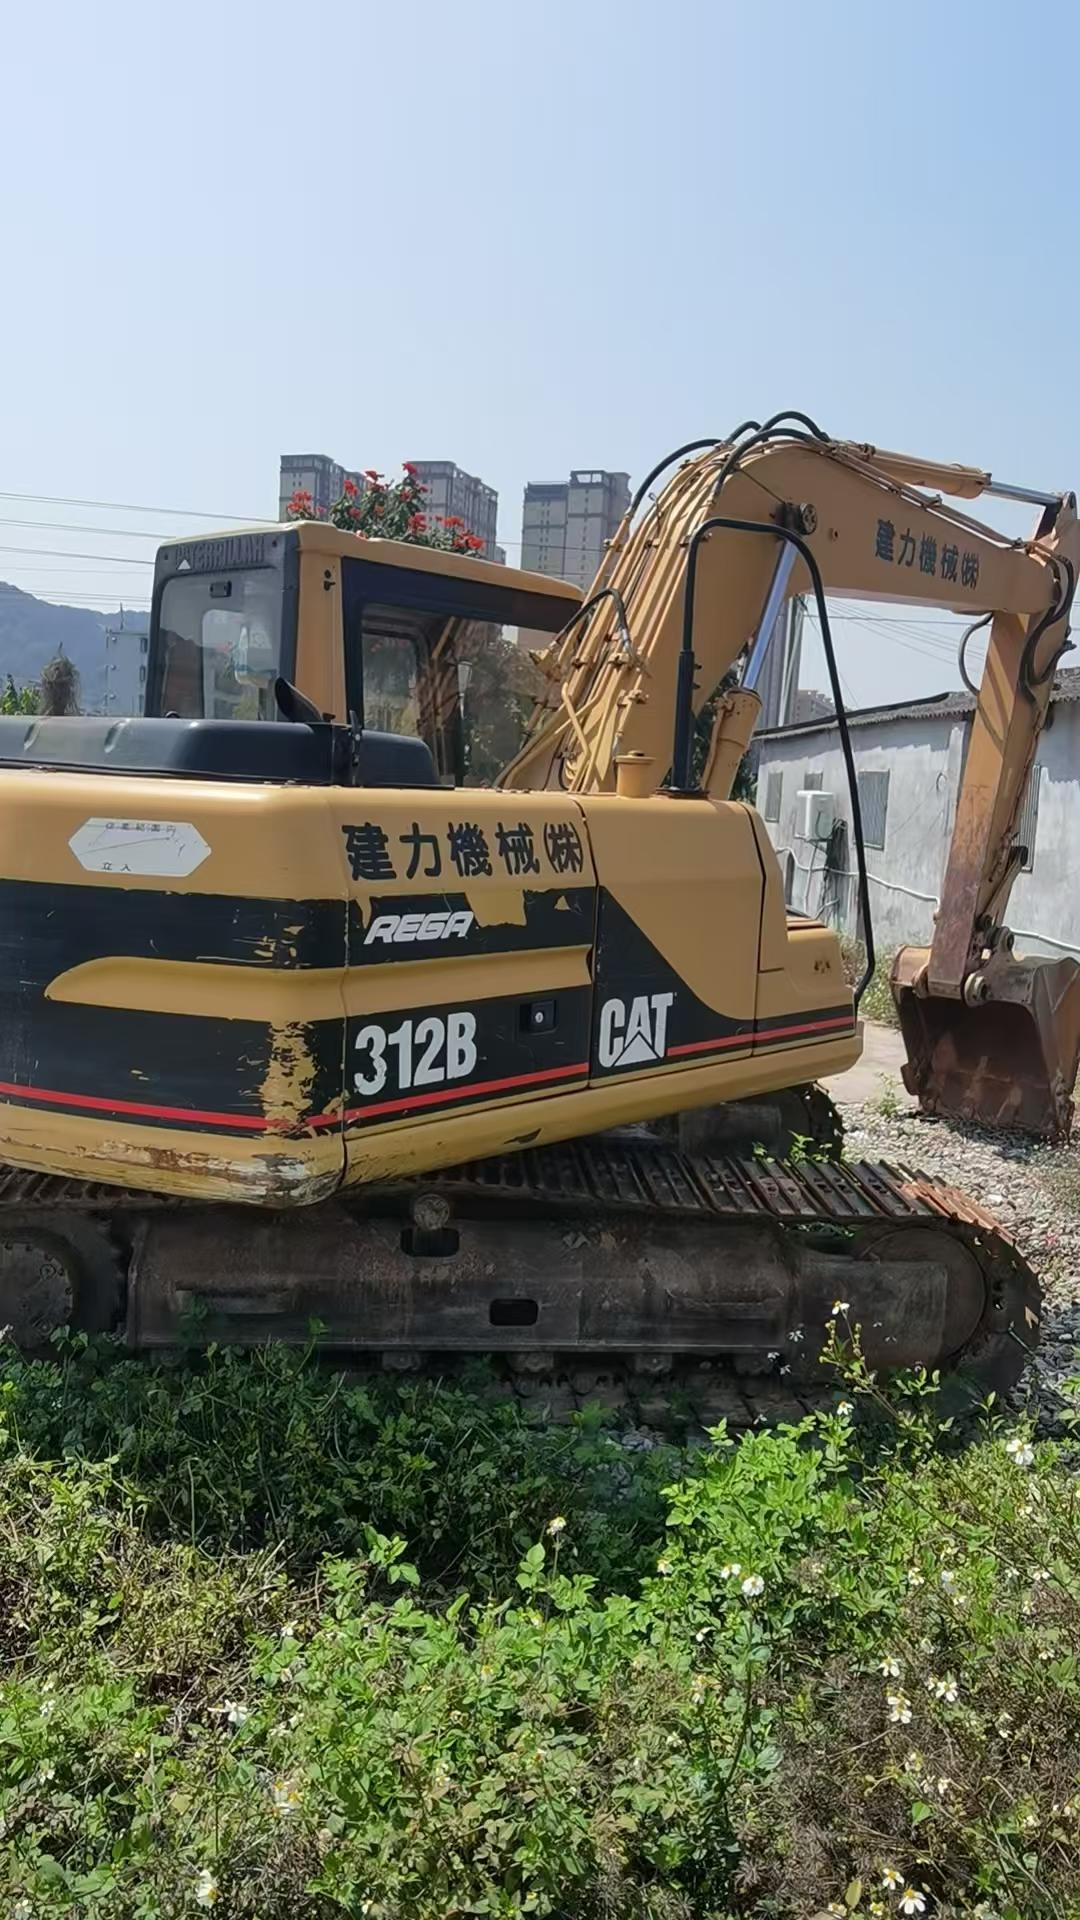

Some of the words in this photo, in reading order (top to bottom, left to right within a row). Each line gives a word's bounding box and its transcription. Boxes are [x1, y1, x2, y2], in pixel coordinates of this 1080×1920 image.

[364, 911, 474, 945] REGA
[354, 1012, 477, 1096] 312B
[599, 992, 674, 1067] CAT
